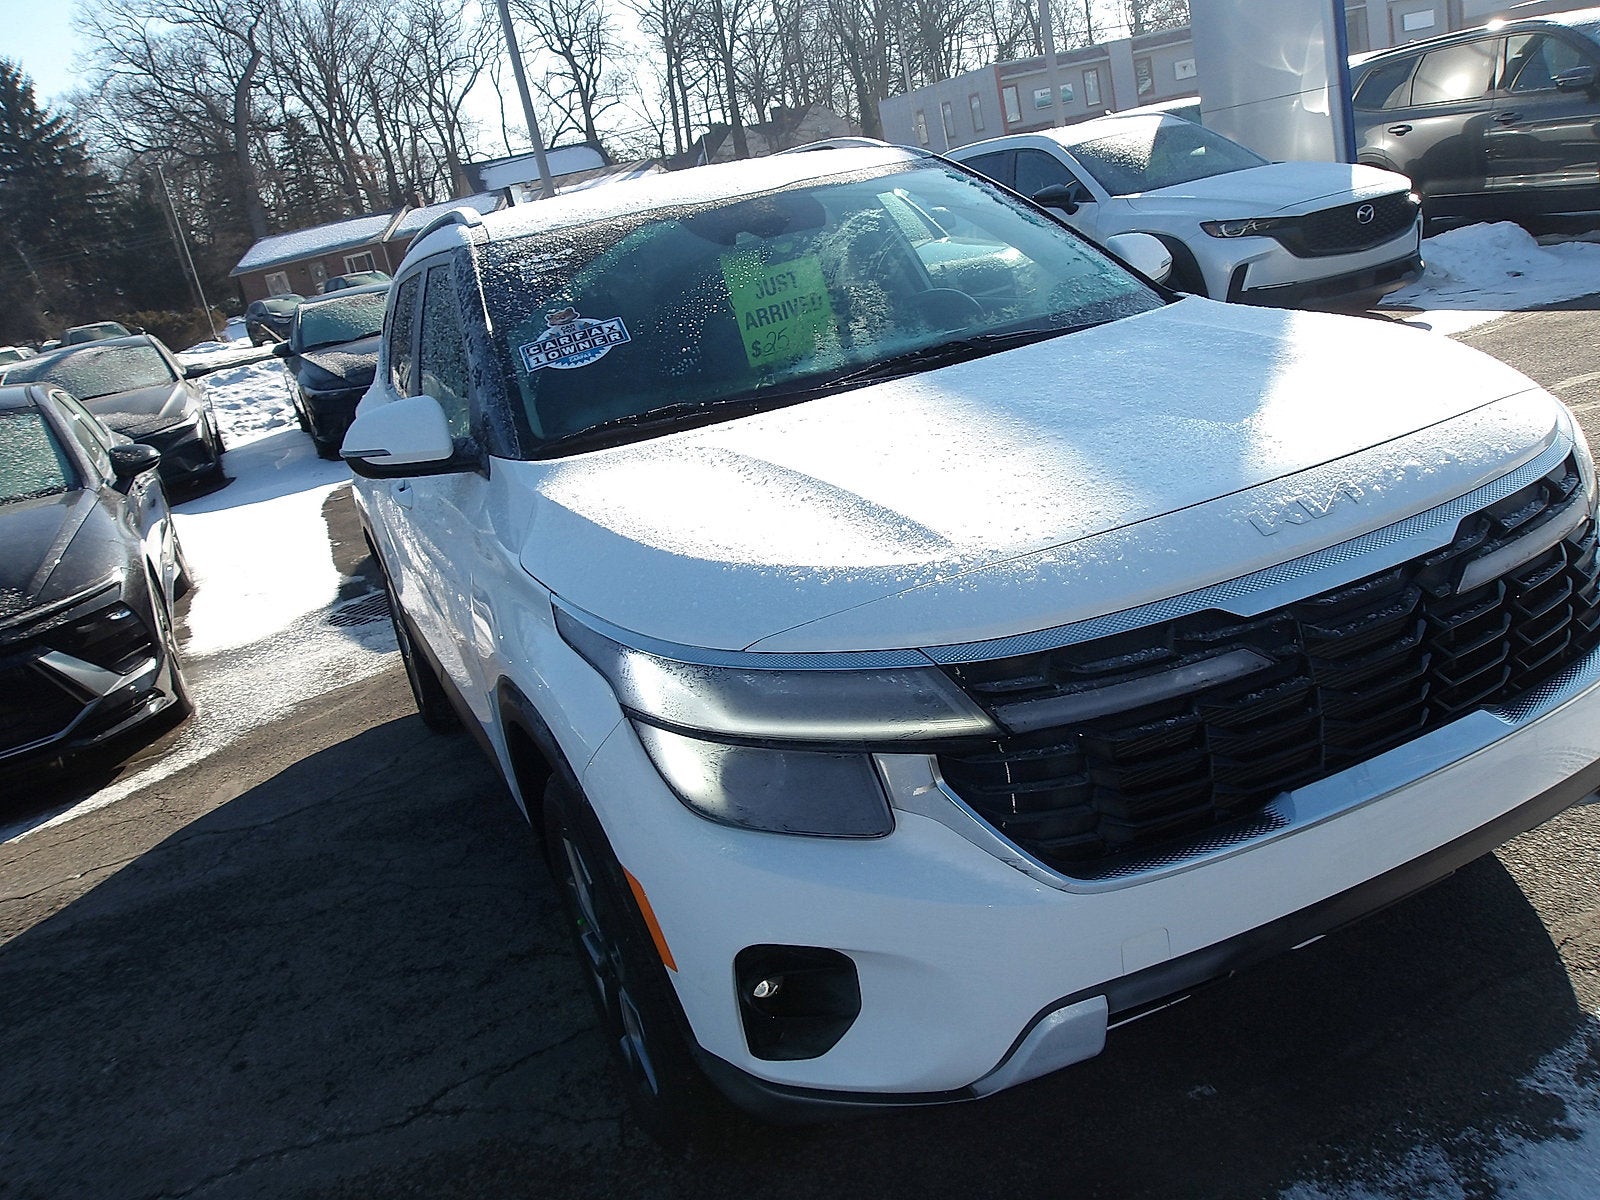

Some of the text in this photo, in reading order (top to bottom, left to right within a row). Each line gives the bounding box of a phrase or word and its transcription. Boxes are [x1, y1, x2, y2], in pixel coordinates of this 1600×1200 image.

[755, 271, 798, 299] JUST
[745, 293, 822, 331] ARRIVED
[528, 324, 617, 354] CARFAX
[532, 332, 621, 365] 1 OWNER
[1248, 480, 1364, 537] KIA
